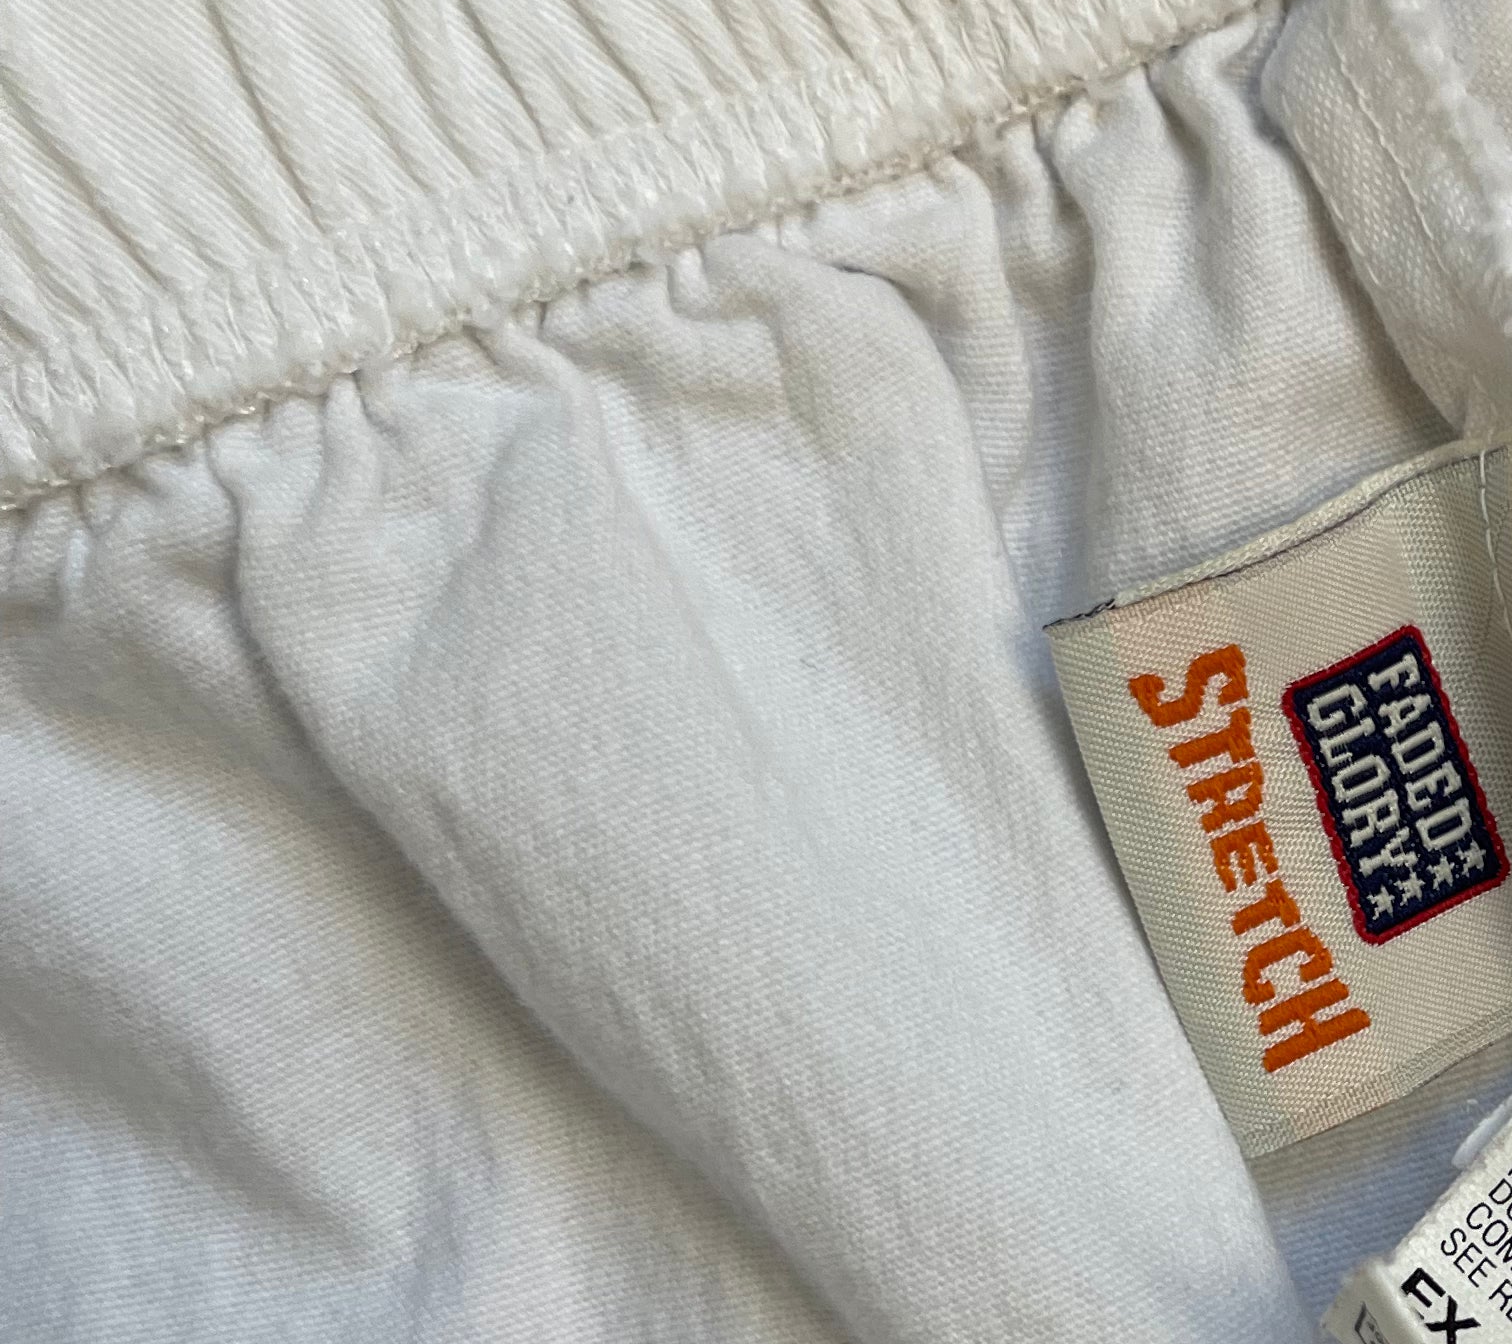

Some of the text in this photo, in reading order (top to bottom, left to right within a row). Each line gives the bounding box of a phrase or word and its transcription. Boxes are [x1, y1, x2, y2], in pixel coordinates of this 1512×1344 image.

[1307, 683, 1418, 877] GLORY
[1368, 652, 1472, 852] FADED
[1128, 644, 1371, 1073] STRETCH
[1441, 1228, 1497, 1287] SEE
